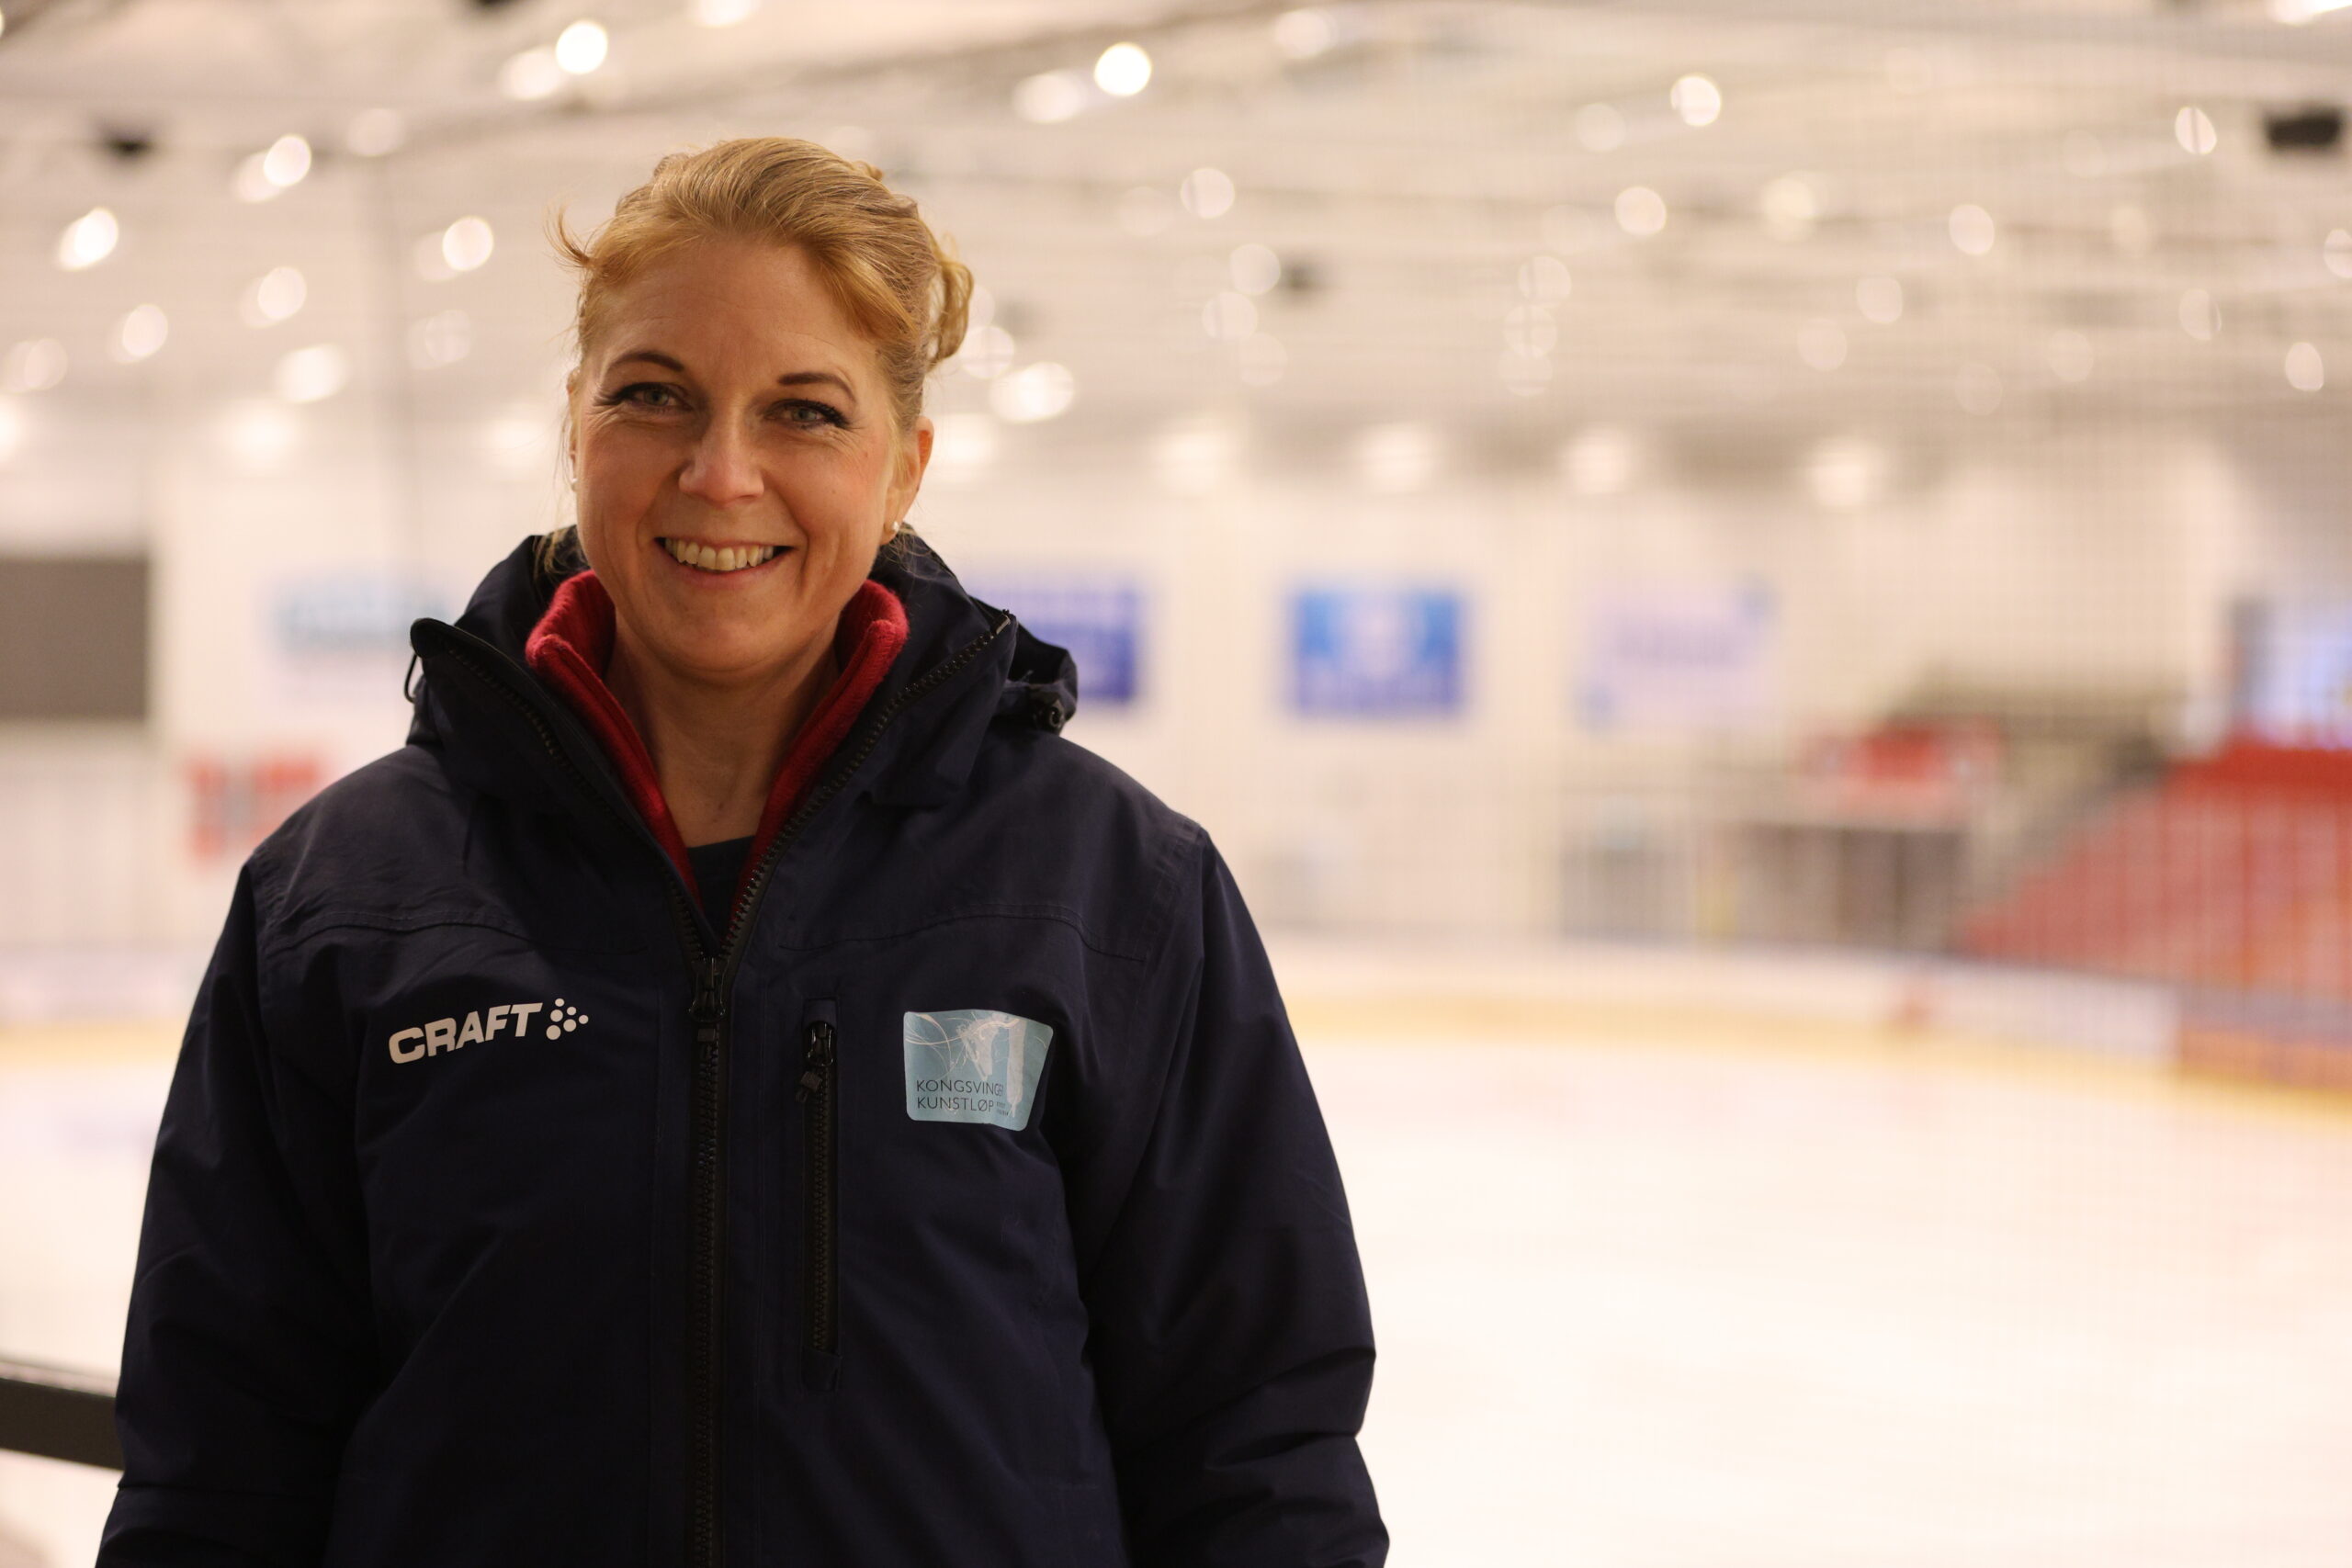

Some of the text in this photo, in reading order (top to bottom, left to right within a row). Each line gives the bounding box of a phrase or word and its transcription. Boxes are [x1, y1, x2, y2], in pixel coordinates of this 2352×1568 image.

[389, 1002, 543, 1064] CRAFT
[916, 1079, 1003, 1097] KONGSVING
[917, 1097, 994, 1112] KUNSTLØP
